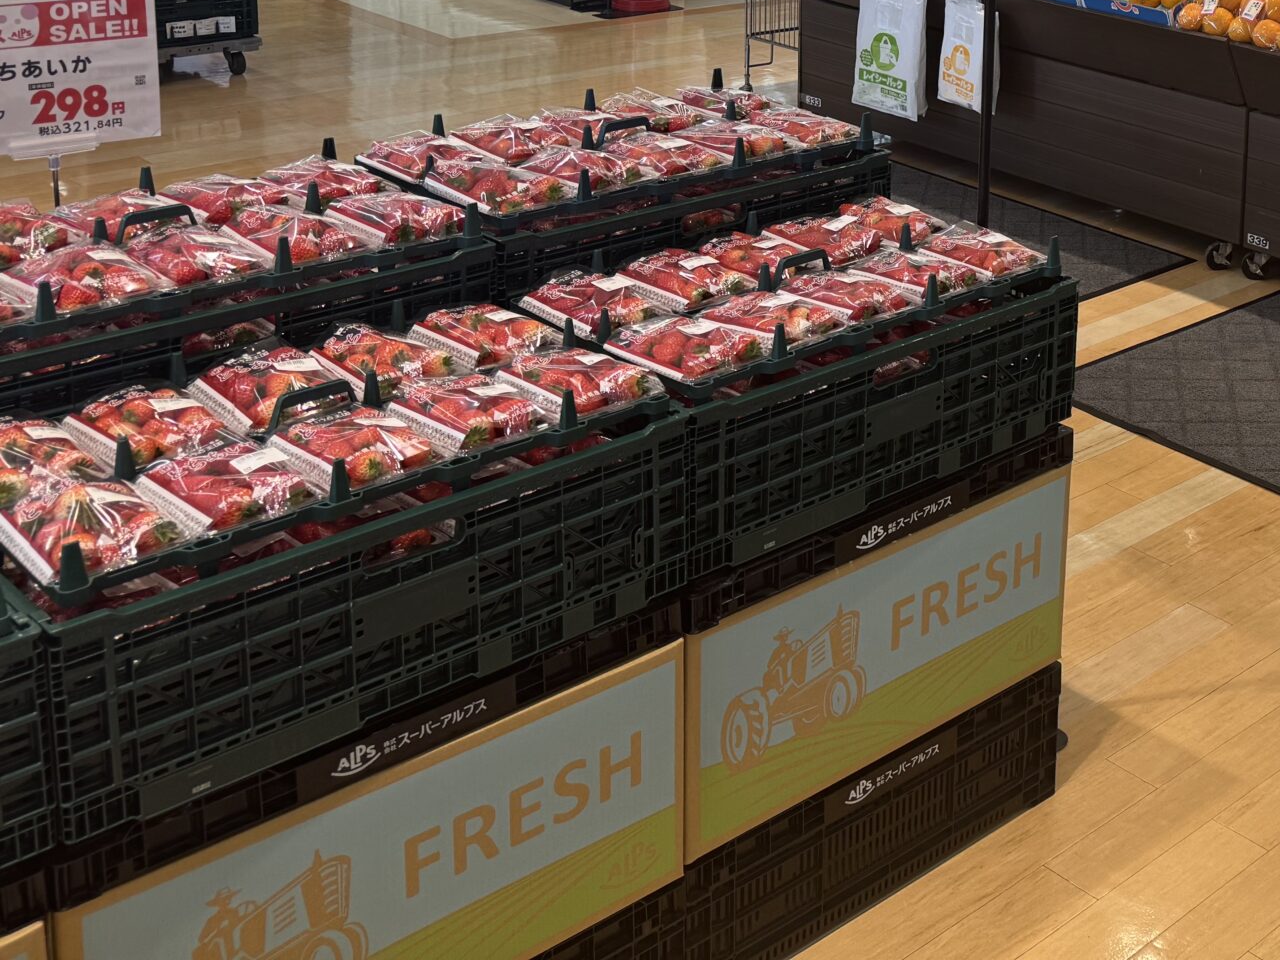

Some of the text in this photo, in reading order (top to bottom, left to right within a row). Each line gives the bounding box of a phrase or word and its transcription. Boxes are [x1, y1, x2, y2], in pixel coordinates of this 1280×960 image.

[11, 27, 33, 40] ALPS
[49, 18, 139, 43] SALE!!
[0, 54, 92, 81] ちあいか
[863, 70, 904, 88] レイシーパック
[38, 116, 123, 137] 税込321.84円
[896, 495, 952, 530] スーパーアルプス
[861, 524, 885, 547] ALPS
[890, 532, 1042, 651] FRESH
[398, 698, 488, 748] スーパーアルプス
[337, 744, 378, 773] ALPS
[884, 744, 940, 782] スーパーアルプス
[848, 779, 874, 801] ALPS
[404, 730, 643, 899] FRESH
